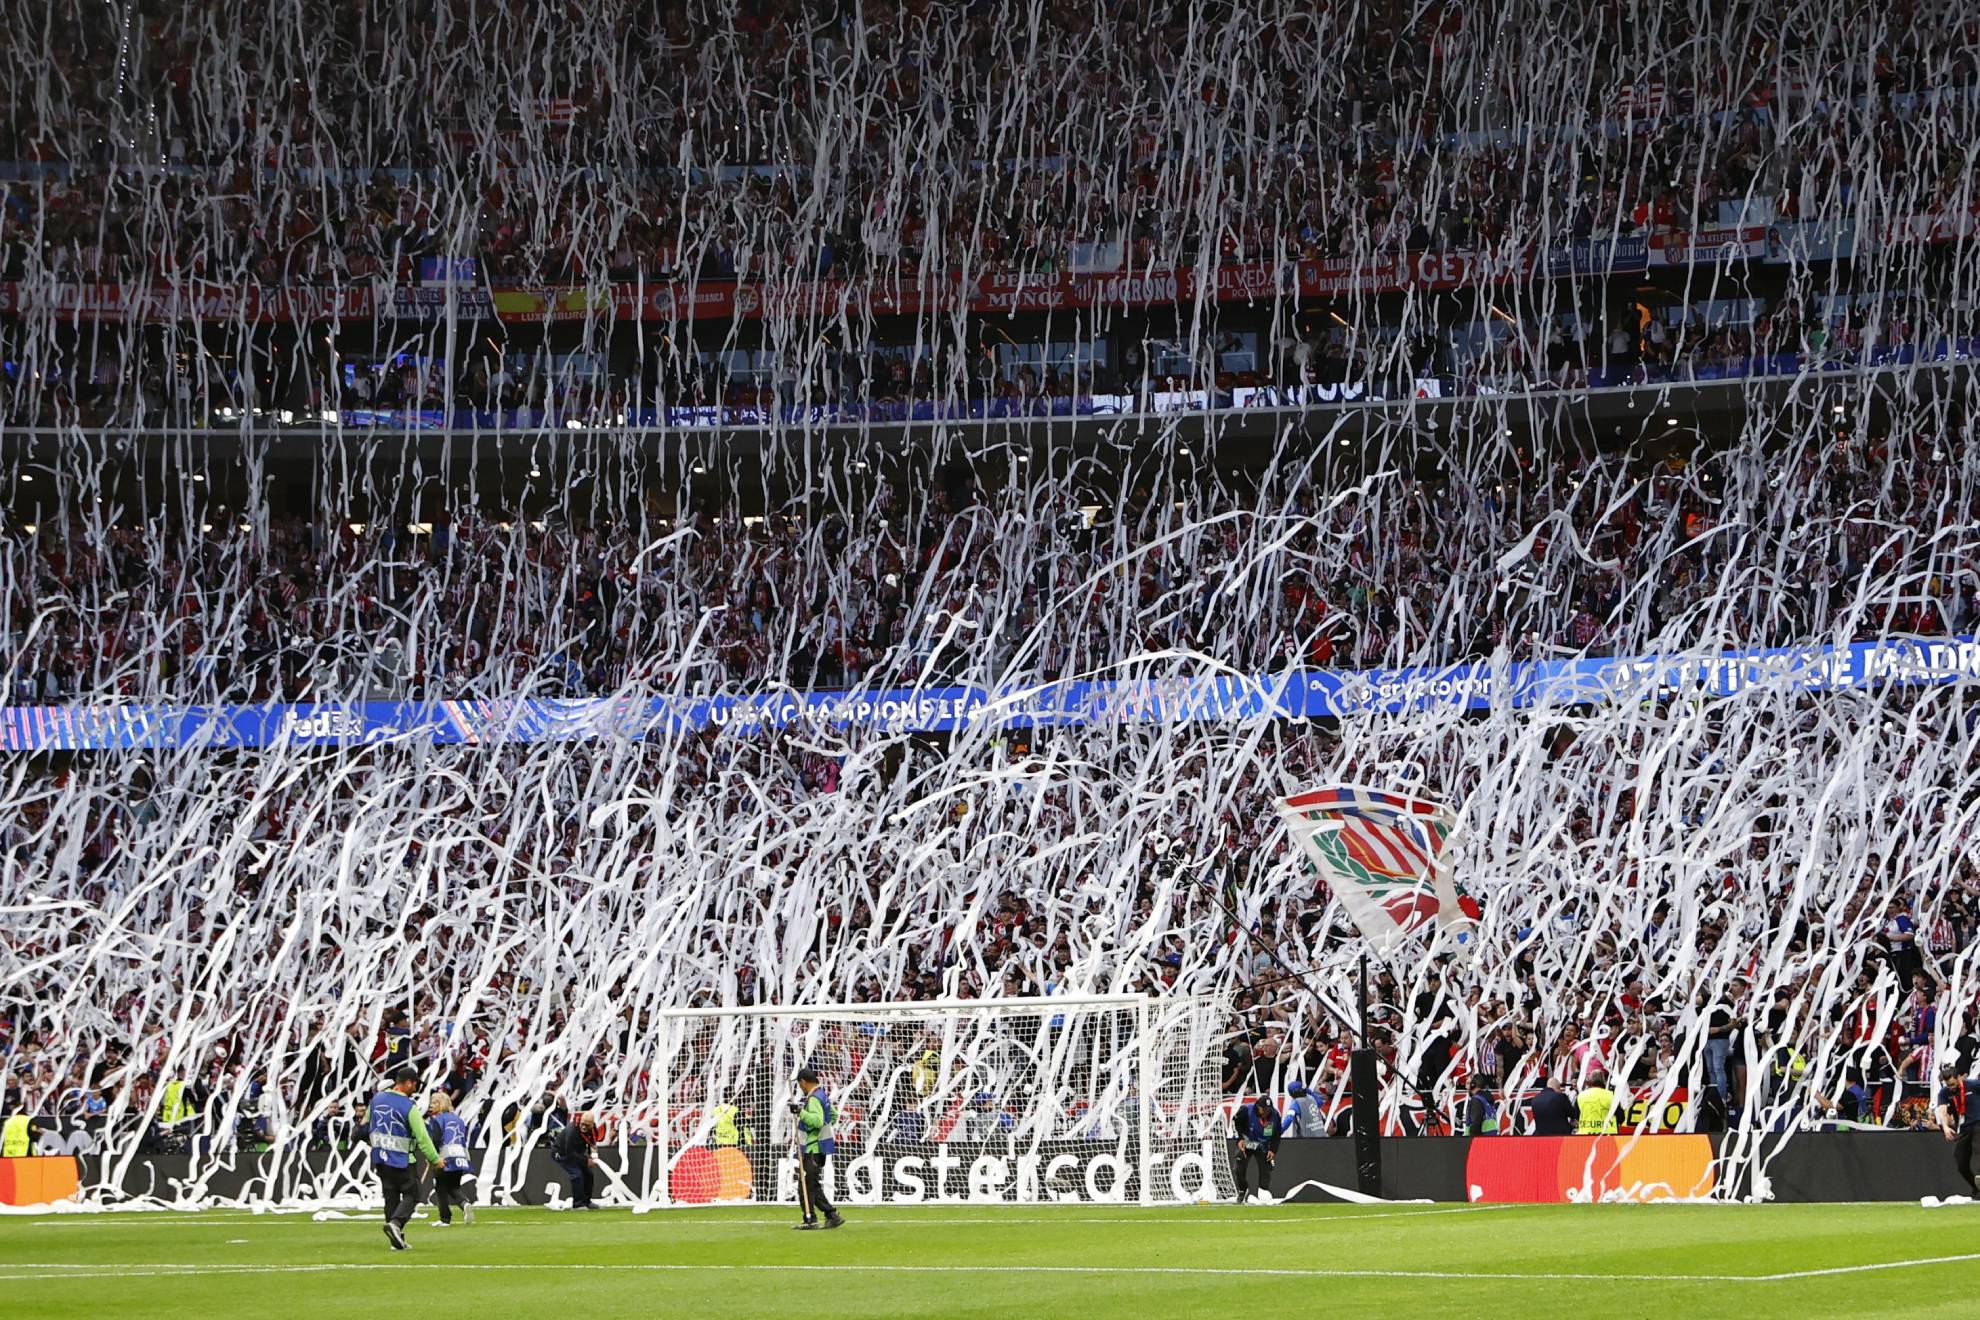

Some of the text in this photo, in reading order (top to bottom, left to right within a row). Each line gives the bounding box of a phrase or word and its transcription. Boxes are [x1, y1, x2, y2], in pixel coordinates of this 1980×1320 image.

[1418, 246, 1528, 283] GETAFE
[993, 272, 1060, 288] PEDRO
[1097, 274, 1177, 303] LOGROÑO
[1186, 266, 1277, 290] SPÚLVEDA
[987, 290, 1064, 307] MUÑOZ
[378, 304, 432, 320] CLLADO
[1612, 655, 1796, 695] ATLTICO
[281, 711, 361, 737] FedEx
[711, 706, 774, 726] UEFA
[780, 701, 938, 724] CHAMPIONS
[1580, 1119, 1615, 1129] SECURY
